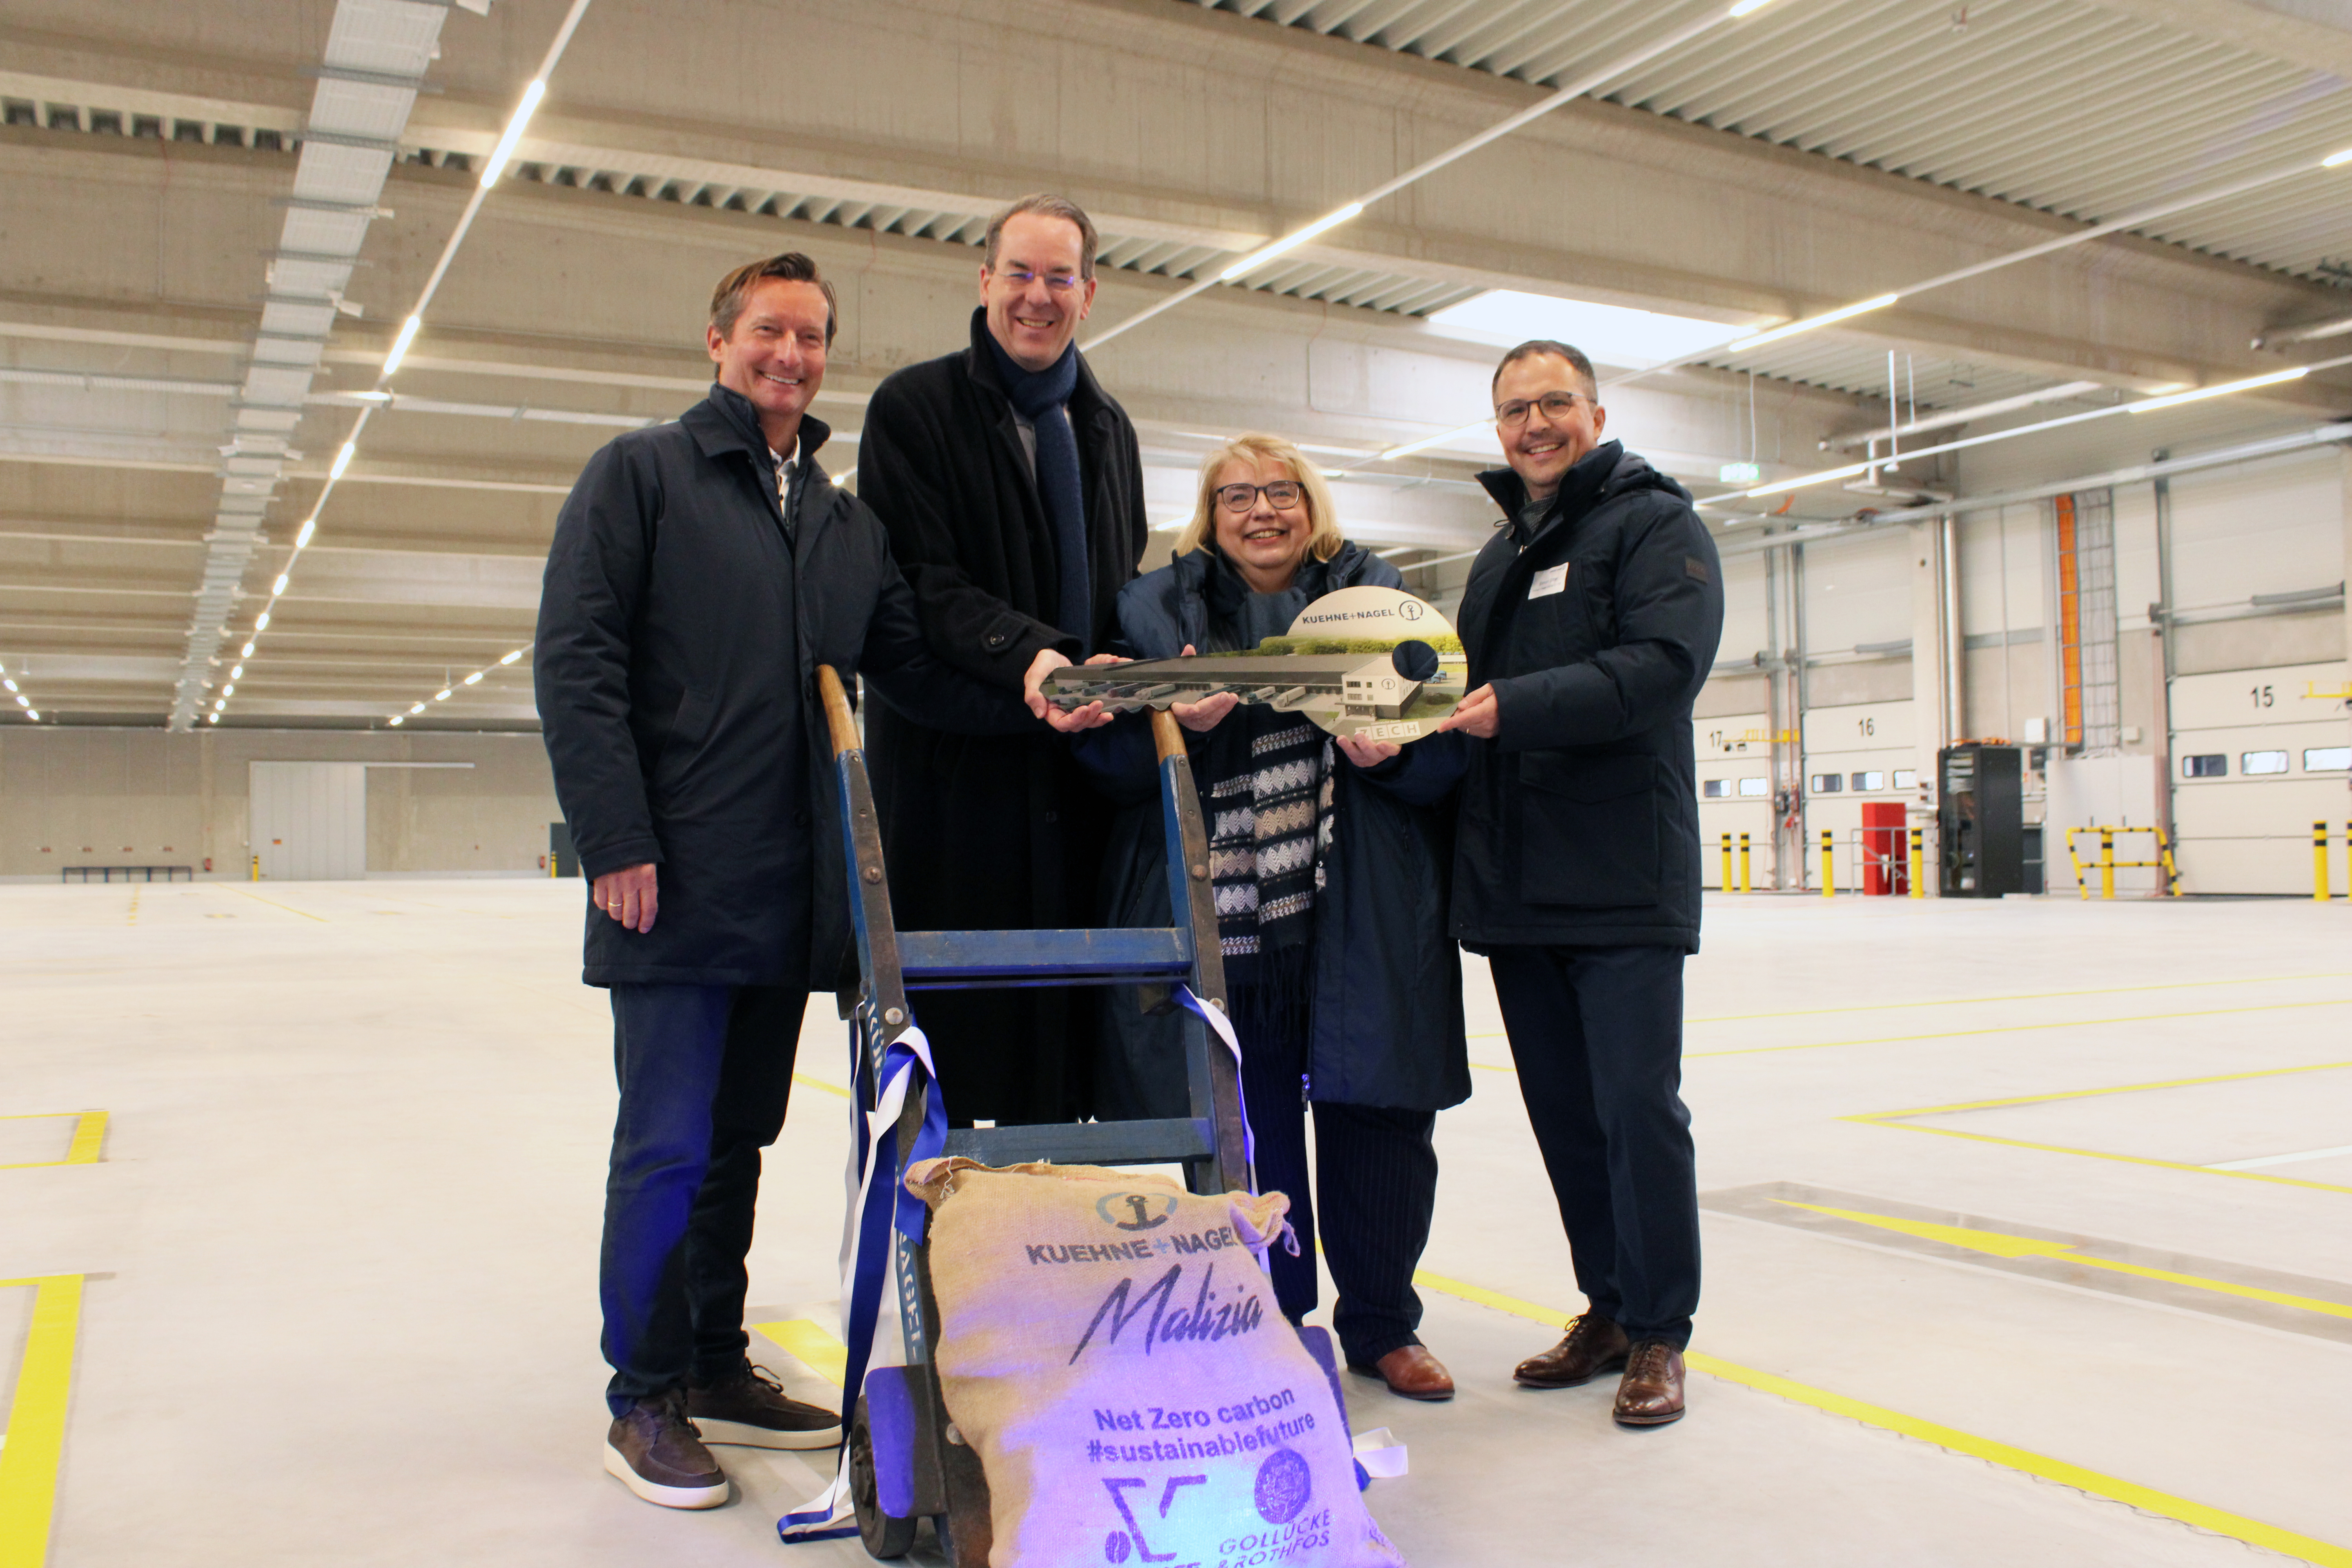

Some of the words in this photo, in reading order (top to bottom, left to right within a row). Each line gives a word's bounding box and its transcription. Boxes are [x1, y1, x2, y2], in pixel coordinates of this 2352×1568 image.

[1302, 609, 1395, 624] KUEHNE+NAGEL
[2250, 685, 2274, 708] 15
[1710, 730, 1723, 748] 17
[1858, 718, 1875, 737] 16
[1068, 1261, 1263, 1366] Malizia
[1093, 1408, 1145, 1431] Net
[1147, 1407, 1211, 1428] Zero
[1218, 1388, 1296, 1424] carbon
[1087, 1412, 1315, 1463] #sustainablefuture
[1219, 1509, 1330, 1555] GOLLÜCKE
